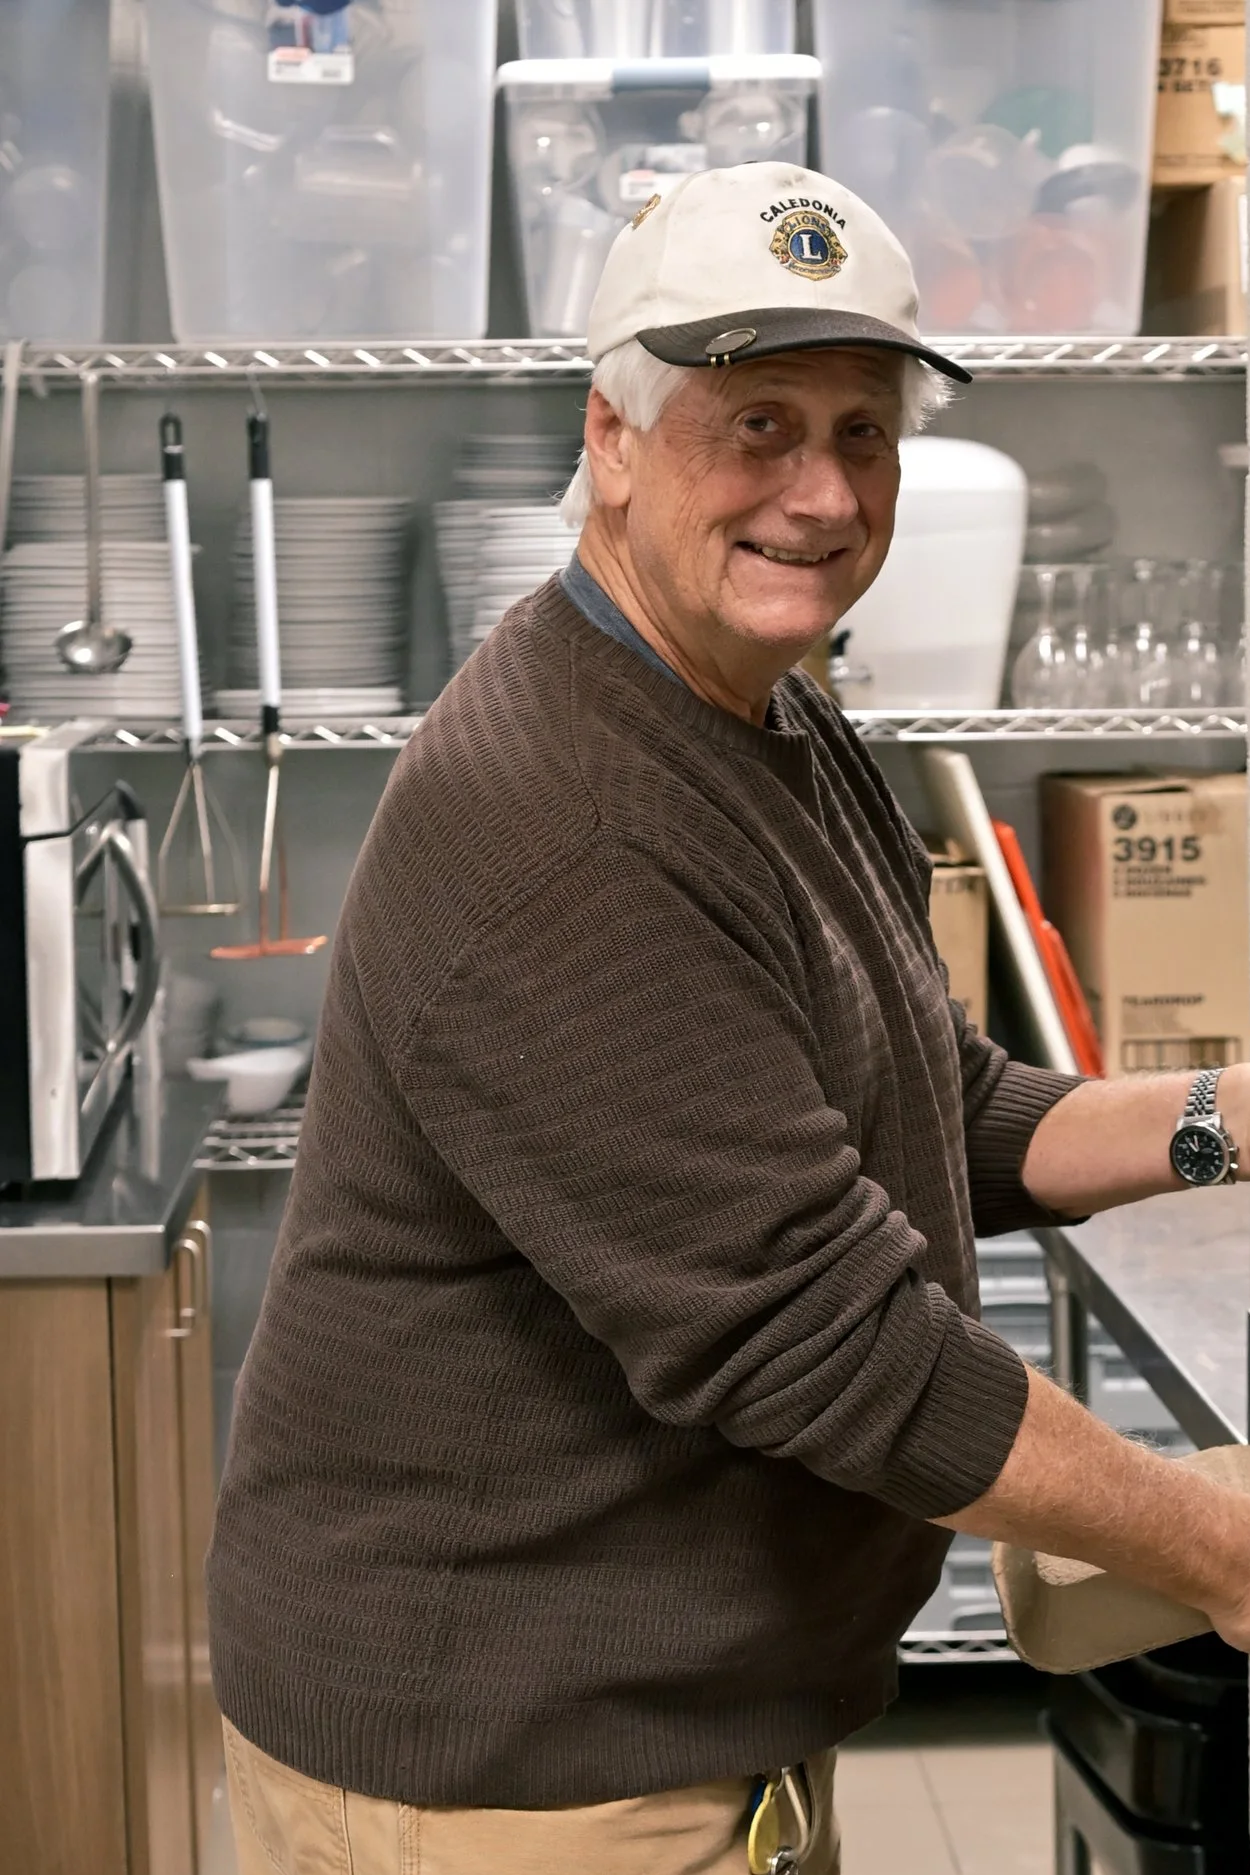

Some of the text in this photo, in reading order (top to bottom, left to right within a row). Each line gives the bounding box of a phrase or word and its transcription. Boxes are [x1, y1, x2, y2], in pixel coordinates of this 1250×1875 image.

[760, 198, 846, 229] CALEDONIA
[800, 234, 822, 259] L
[1112, 835, 1203, 862] 3915
